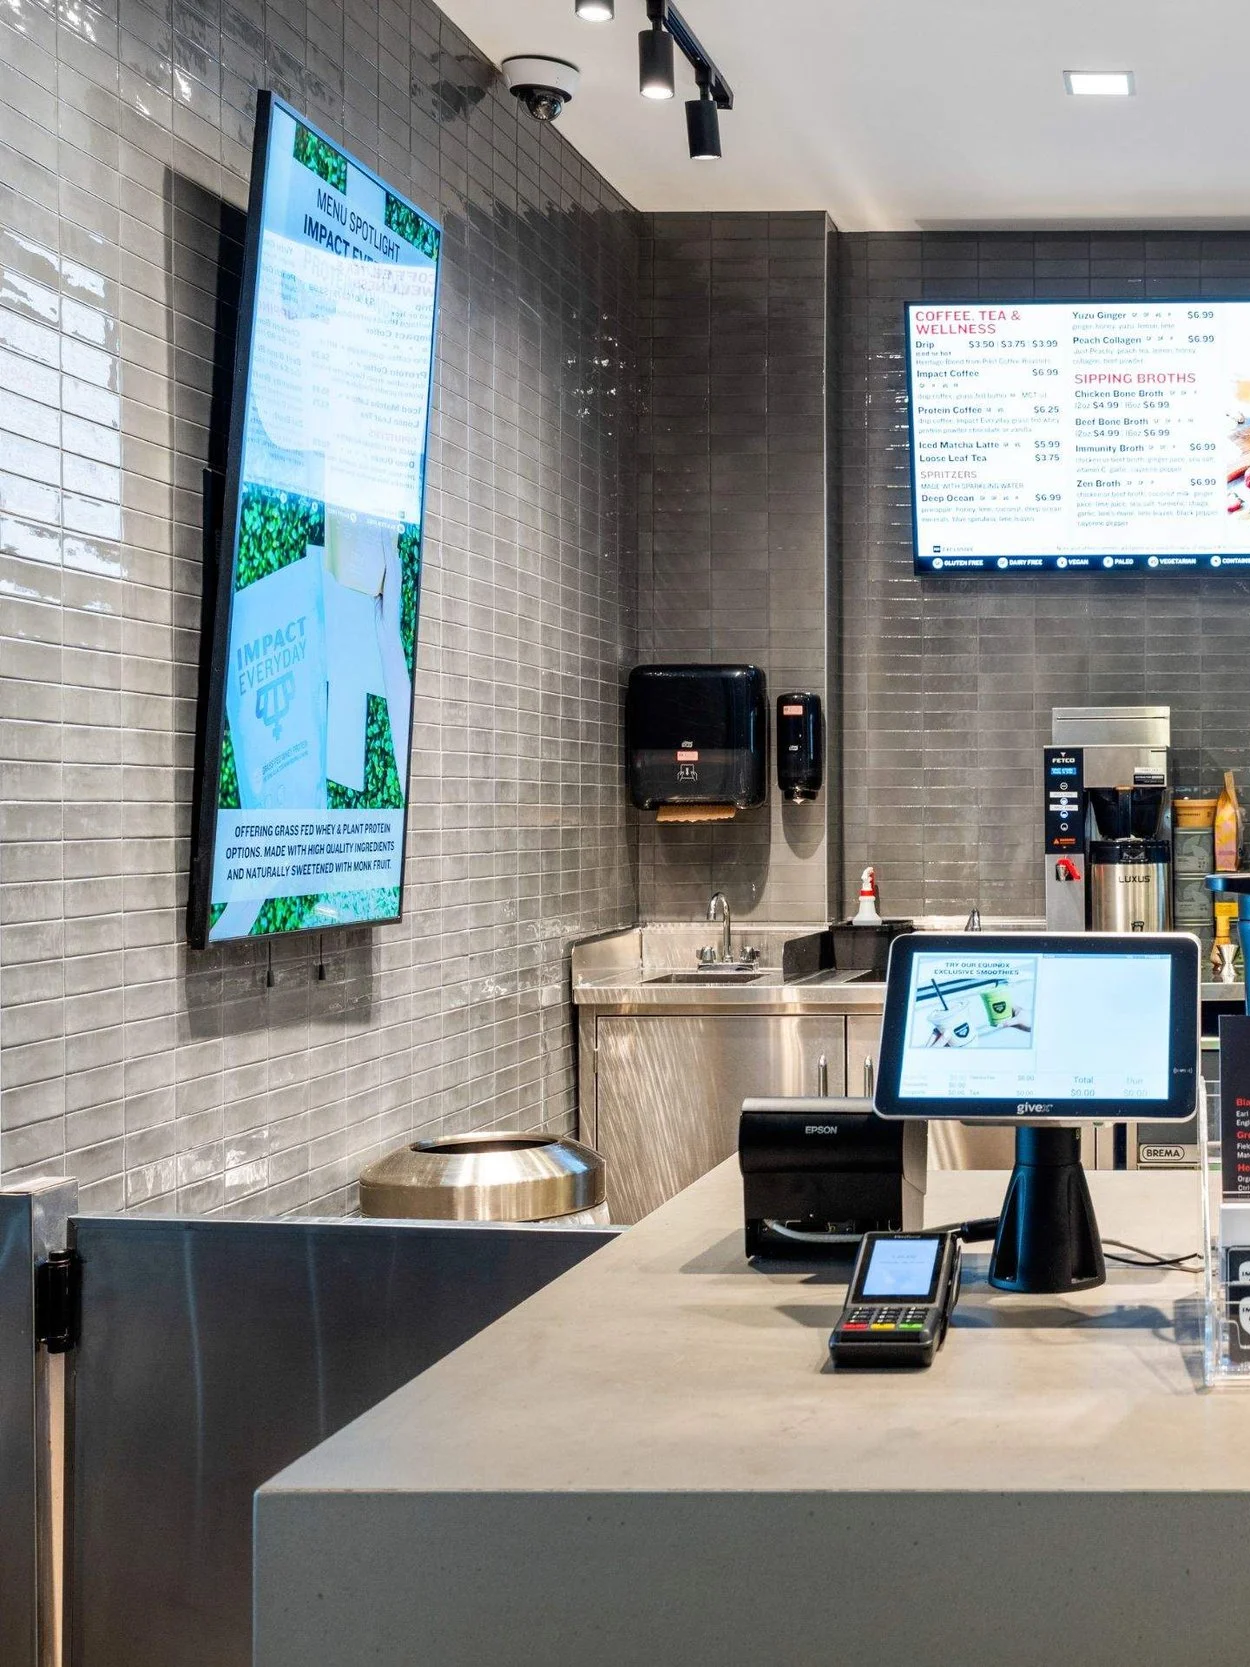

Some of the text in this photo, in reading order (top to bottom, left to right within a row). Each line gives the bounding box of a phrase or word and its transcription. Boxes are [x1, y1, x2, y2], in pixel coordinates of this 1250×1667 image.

[317, 189, 400, 262] MENU SPOTLIGHT
[304, 214, 349, 258] IMPACT
[980, 311, 1006, 321] TEA
[1010, 311, 1021, 321] &
[1097, 312, 1126, 321] Ginger
[1187, 311, 1214, 319] $6.99
[916, 324, 996, 335] WELLNESS
[915, 340, 1058, 349] Drip $3.50 $3.75 $3.99
[1073, 336, 1141, 346] Peach Collagen
[1188, 335, 1214, 344] $6.99
[916, 370, 979, 379] Impact Coffee
[1032, 369, 1059, 377] $6.99
[1074, 373, 1196, 384] SIPPING BROTHS
[1075, 390, 1163, 398] Chicken Bone Broth
[236, 616, 306, 670] IMPACT
[239, 639, 307, 696] EVERYDAY
[235, 823, 391, 838] OFFERING GRASS FED WHEY & PLANT PROTEIN
[226, 841, 394, 859] OPTIONS. MADE WITH HIGH QUALITY INGREDIENTS
[227, 859, 391, 880] AND NATURALLY SWEETENED WITH MONK FRUIT.
[1074, 1076, 1094, 1085] Total
[1071, 1089, 1095, 1098] $0.00
[1017, 1103, 1049, 1115] givex
[805, 1126, 837, 1134] EPSON
[1147, 1149, 1180, 1157] BREMA
